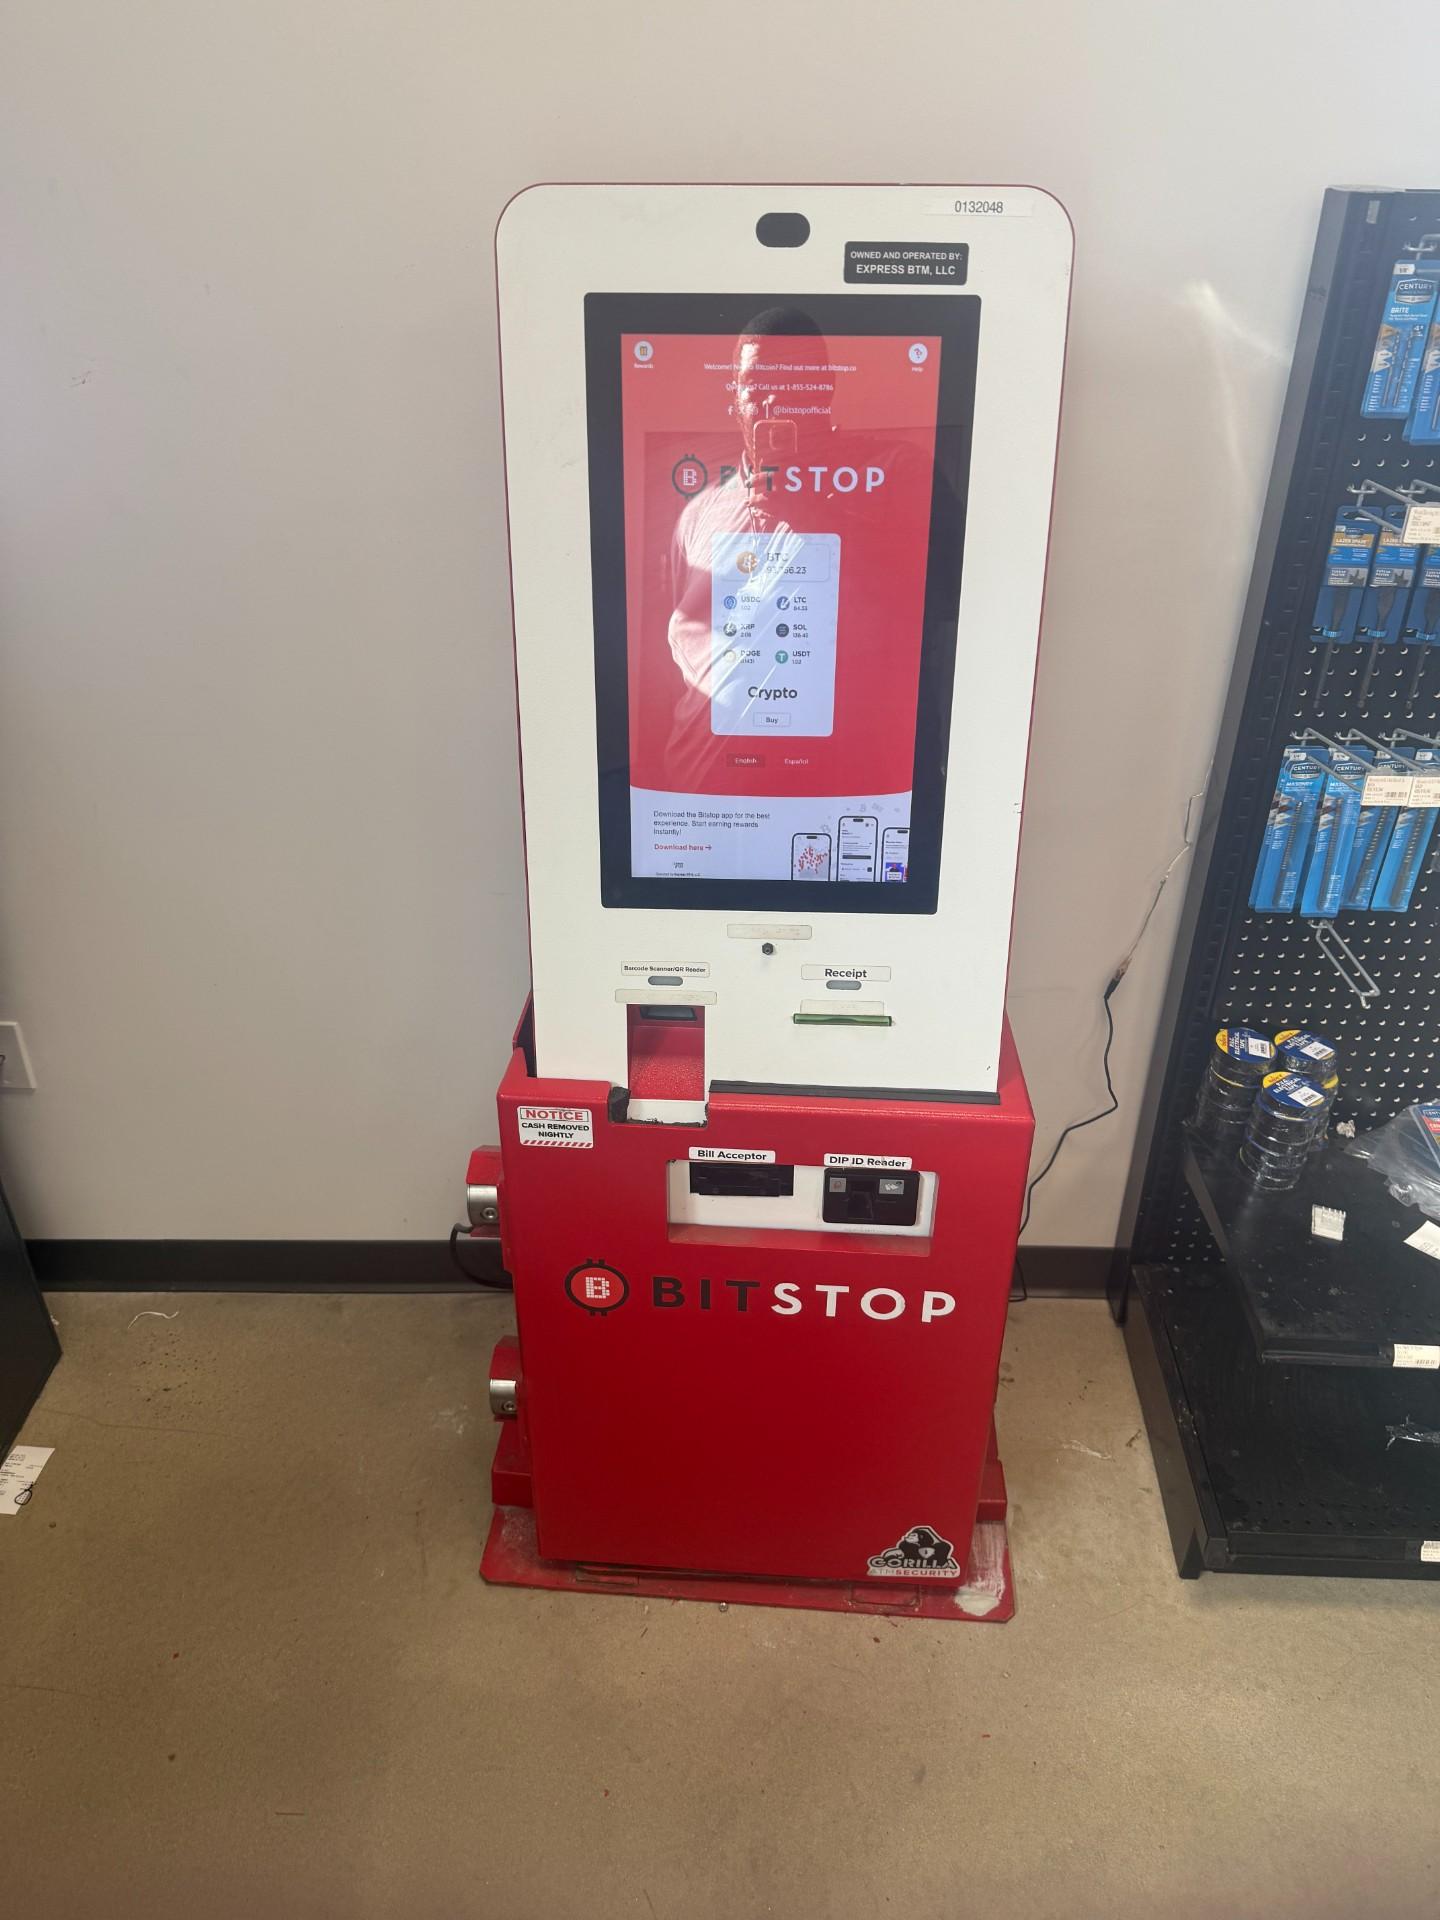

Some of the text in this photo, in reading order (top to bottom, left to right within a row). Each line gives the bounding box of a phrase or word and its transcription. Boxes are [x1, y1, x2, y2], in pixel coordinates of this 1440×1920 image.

[954, 200, 1004, 214] 0132048
[850, 251, 882, 259] OWNED
[883, 251, 901, 260] AND
[902, 252, 947, 260] OPERATED
[856, 265, 956, 276] EXPRESS BTM, LLC
[773, 405, 832, 415] @bitstopofficial
[766, 552, 789, 561] BTC
[792, 650, 811, 658] USDT
[747, 686, 798, 701] Crypto
[765, 716, 779, 725] Buy
[735, 757, 757, 766] English
[784, 757, 809, 767] Español
[653, 810, 685, 818] Download
[698, 812, 720, 820] Bitstop
[708, 821, 732, 829] earning
[824, 967, 868, 978] Receipt
[525, 1109, 584, 1121] NOTICE
[547, 1123, 590, 1131] REMOVED
[538, 1131, 575, 1139] NIGHTLY
[697, 1149, 768, 1161] Bill Acceptor
[829, 1156, 907, 1167] DIP ID Reader
[651, 1275, 957, 1324] BITSTOP
[870, 1557, 956, 1569] GORILLA
